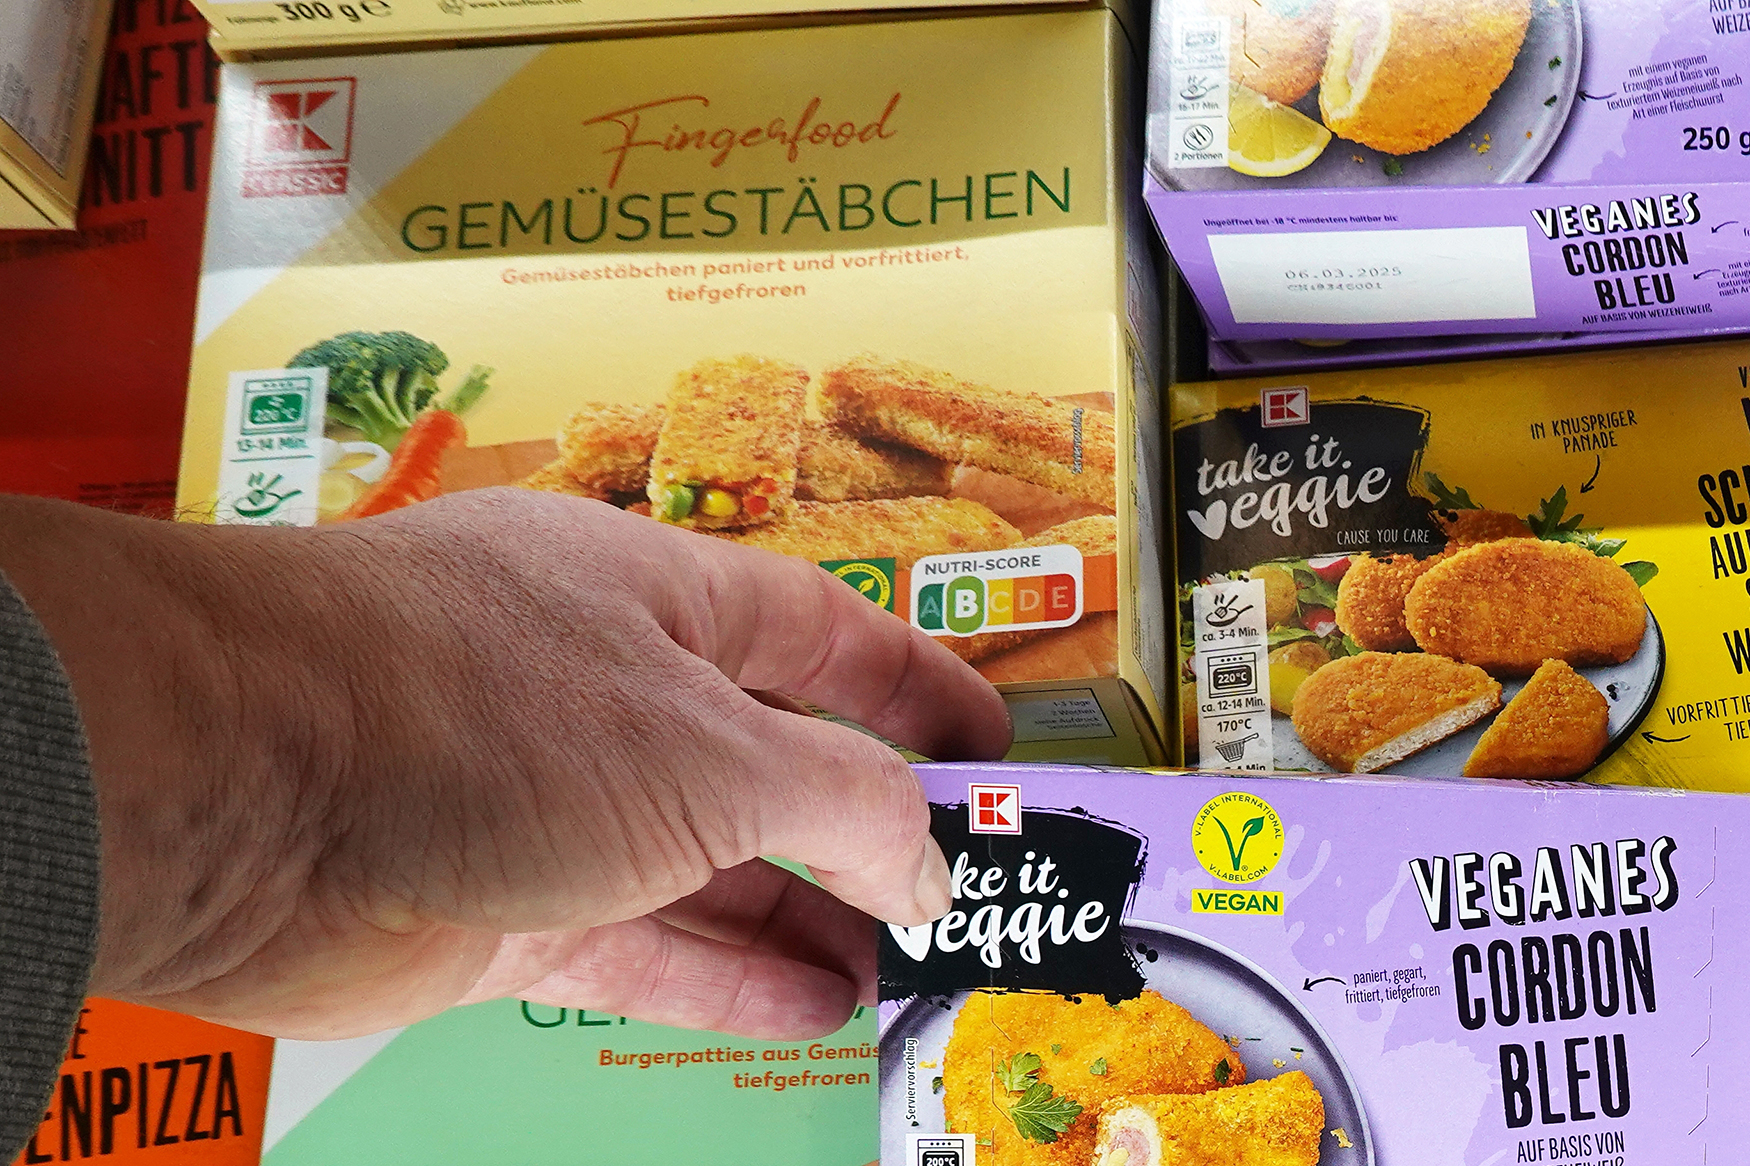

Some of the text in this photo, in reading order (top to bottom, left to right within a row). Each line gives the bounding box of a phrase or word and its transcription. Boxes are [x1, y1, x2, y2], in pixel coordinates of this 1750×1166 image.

[582, 93, 901, 189] Fingerfood
[1683, 128, 1731, 150] 250
[1183, 151, 1223, 161] Portionen
[400, 166, 1071, 254] GEMÜSESTÄBCHEN
[1532, 192, 1701, 239] VEGANES
[502, 245, 970, 286] Gemüsestäbchen paniert und vorfrittiert,
[1562, 232, 1689, 276] CORDON
[1285, 266, 1402, 280] 06.03.2025
[667, 282, 806, 304] tiefgefroren
[1594, 274, 1676, 310] BLEU
[1530, 410, 1637, 439] IN KNUSPRIGER
[1562, 431, 1618, 453] PANADE
[1197, 434, 1342, 496] take it
[1337, 528, 1430, 545] CAUSE YOU CARE
[925, 555, 1041, 575] NUTRI-SCORE
[1218, 630, 1234, 641] 3-4
[1409, 835, 1679, 931] VEGANES
[1353, 966, 1427, 988] paniert, gegart,
[1451, 926, 1657, 1031] CORDON
[1345, 981, 1441, 1004] frittiert, tiefgefroren
[599, 1048, 801, 1073] Burgerpatties aus
[733, 1069, 871, 1090] tiefgefroren
[906, 1037, 918, 1121] Serviervorschlag
[1498, 1034, 1632, 1129] BLEU
[926, 1156, 955, 1166] 200°C
[1517, 1131, 1625, 1164] AUF BASIS VON
